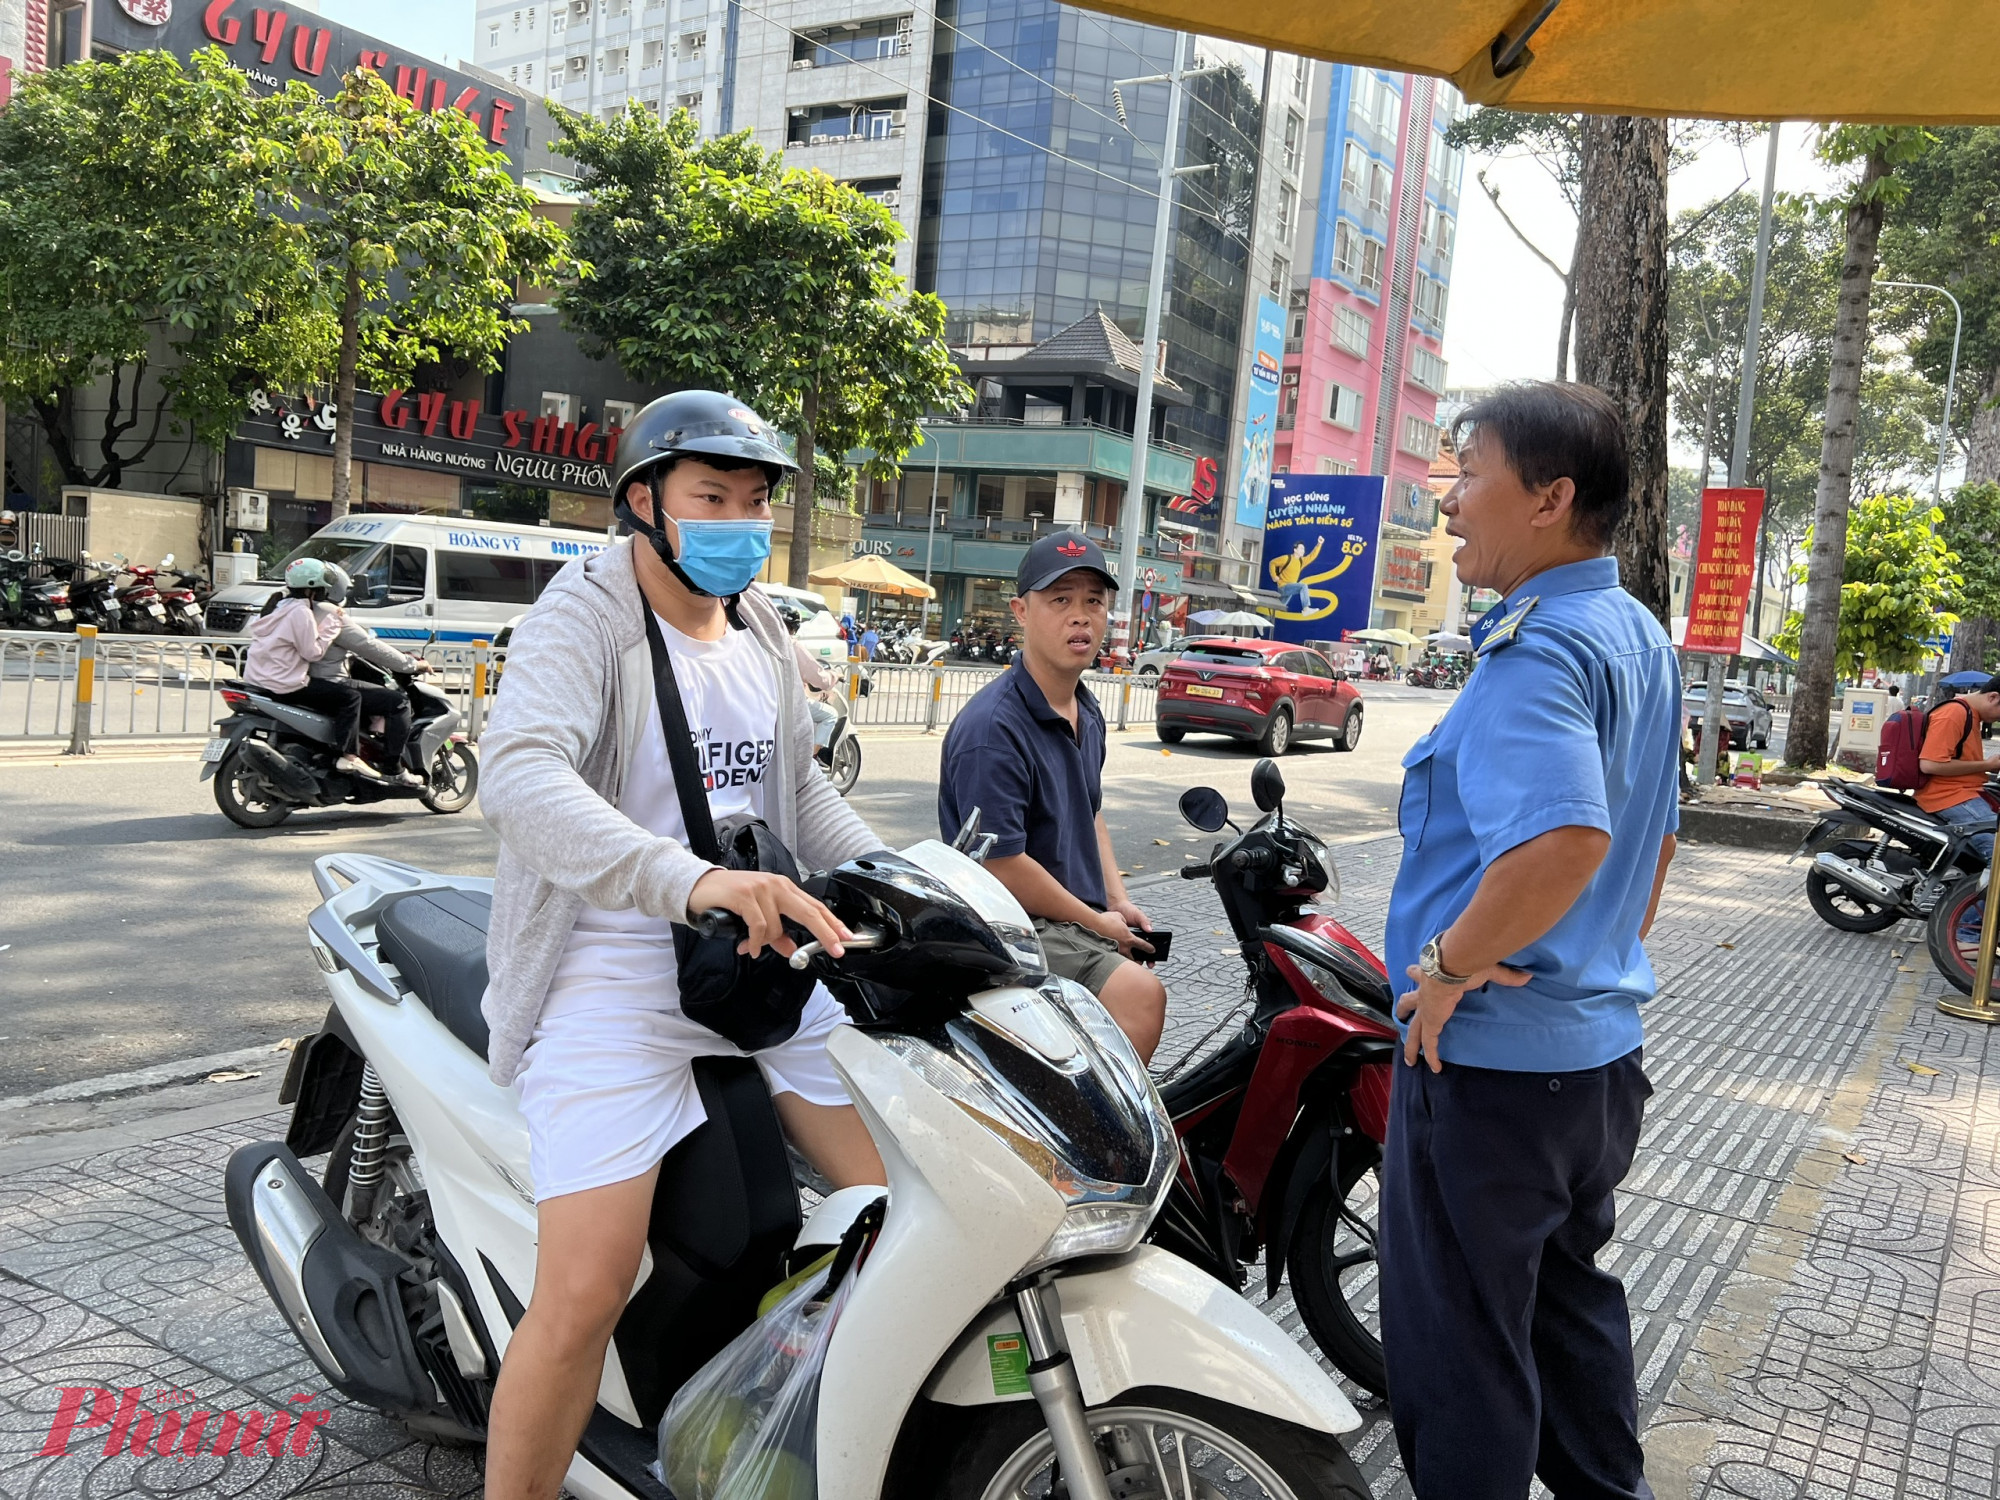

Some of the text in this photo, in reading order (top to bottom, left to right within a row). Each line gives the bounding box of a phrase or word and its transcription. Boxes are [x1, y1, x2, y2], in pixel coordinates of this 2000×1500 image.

[204, 0, 332, 76] GYU
[246, 67, 278, 88] HÀNG
[381, 389, 481, 441] GYU
[382, 442, 407, 458] NHÀ
[410, 445, 442, 463] HÀNG
[445, 453, 486, 470] NƯỚNG
[1284, 491, 1330, 505] HỌC ĐÚNG
[1268, 504, 1345, 519] LUYỆN NHANH
[1266, 518, 1293, 530] NÂNG
[1340, 517, 1355, 528] SỐ
[448, 531, 521, 551] HOÀNG VỸ
[852, 540, 893, 556] OURS
